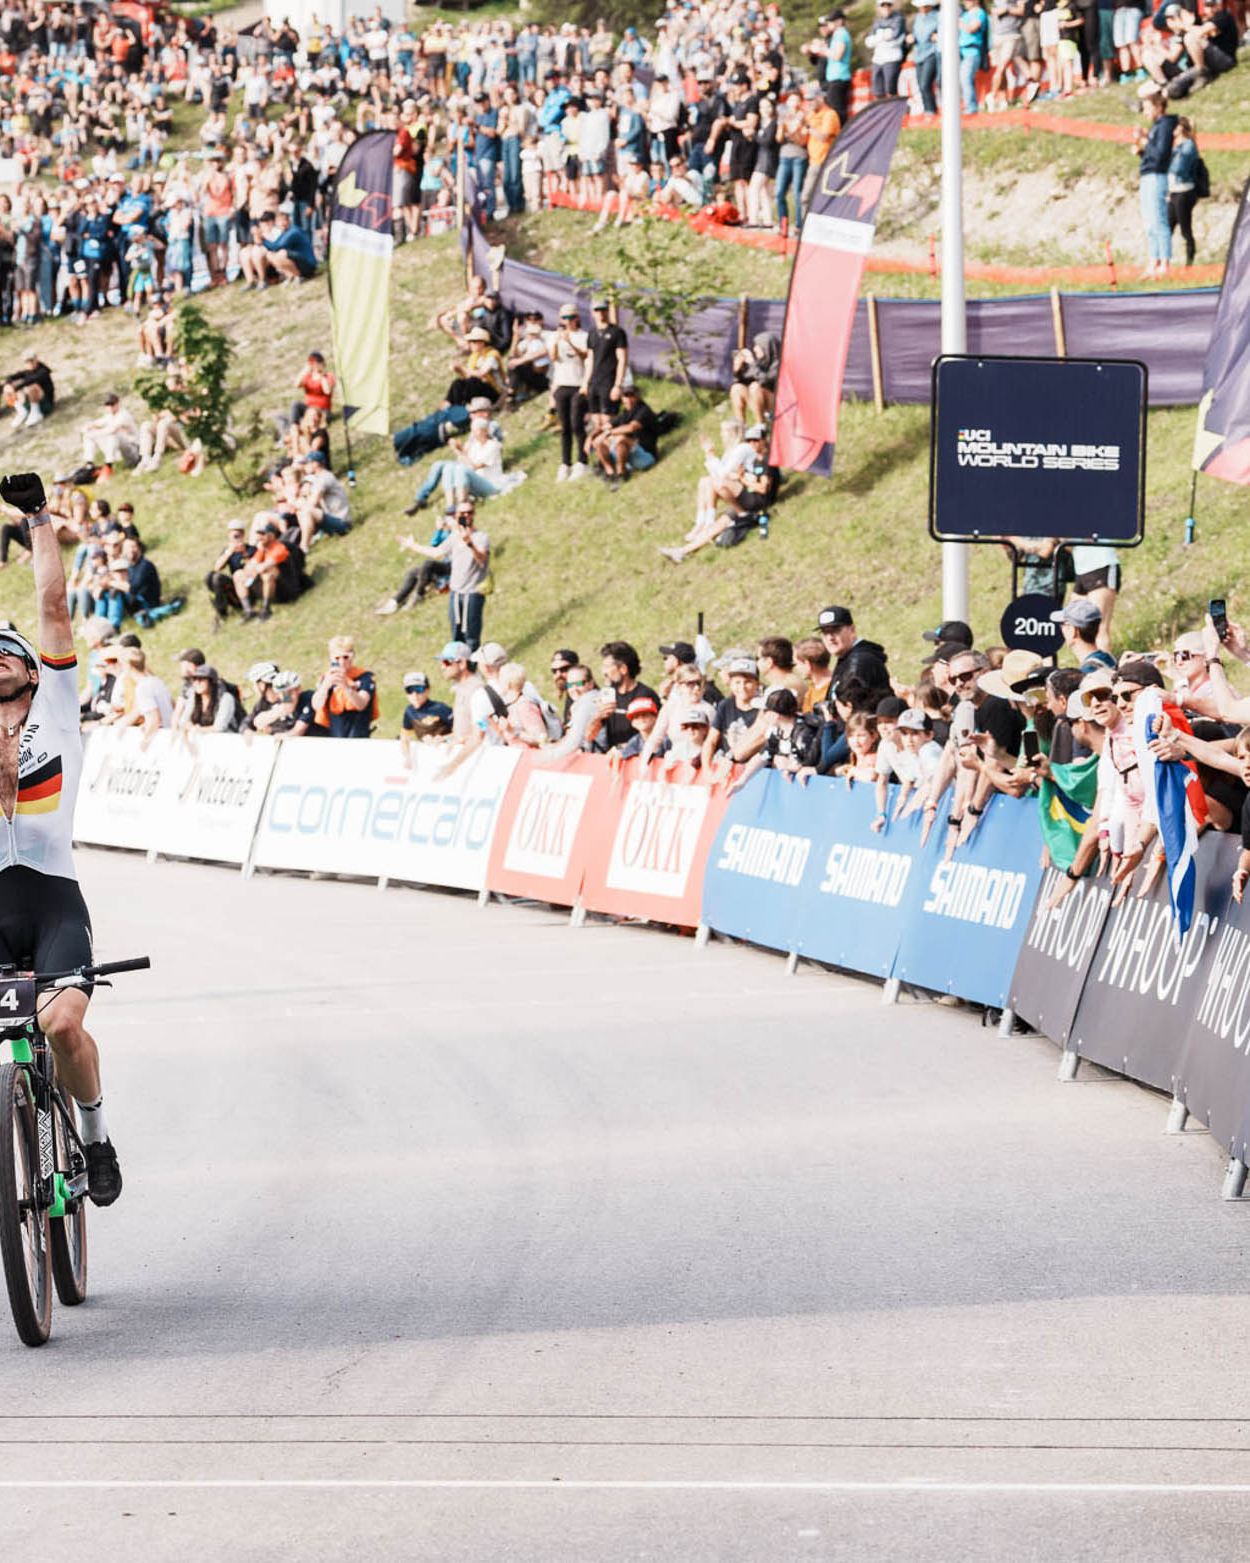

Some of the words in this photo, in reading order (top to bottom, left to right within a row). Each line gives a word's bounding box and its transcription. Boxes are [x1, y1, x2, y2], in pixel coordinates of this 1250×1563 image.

[964, 429, 991, 442] UCI
[957, 441, 1068, 457] MOUNTAIN
[1070, 444, 1120, 458] BIKE
[957, 454, 1039, 468] WORLD
[1042, 456, 1120, 471] SERIES
[1014, 616, 1056, 636] 20m
[717, 823, 812, 887] SHIMANO
[819, 843, 913, 908] SHIMANO
[922, 860, 1027, 930] SHIMANO
[0, 988, 19, 1011] 4
